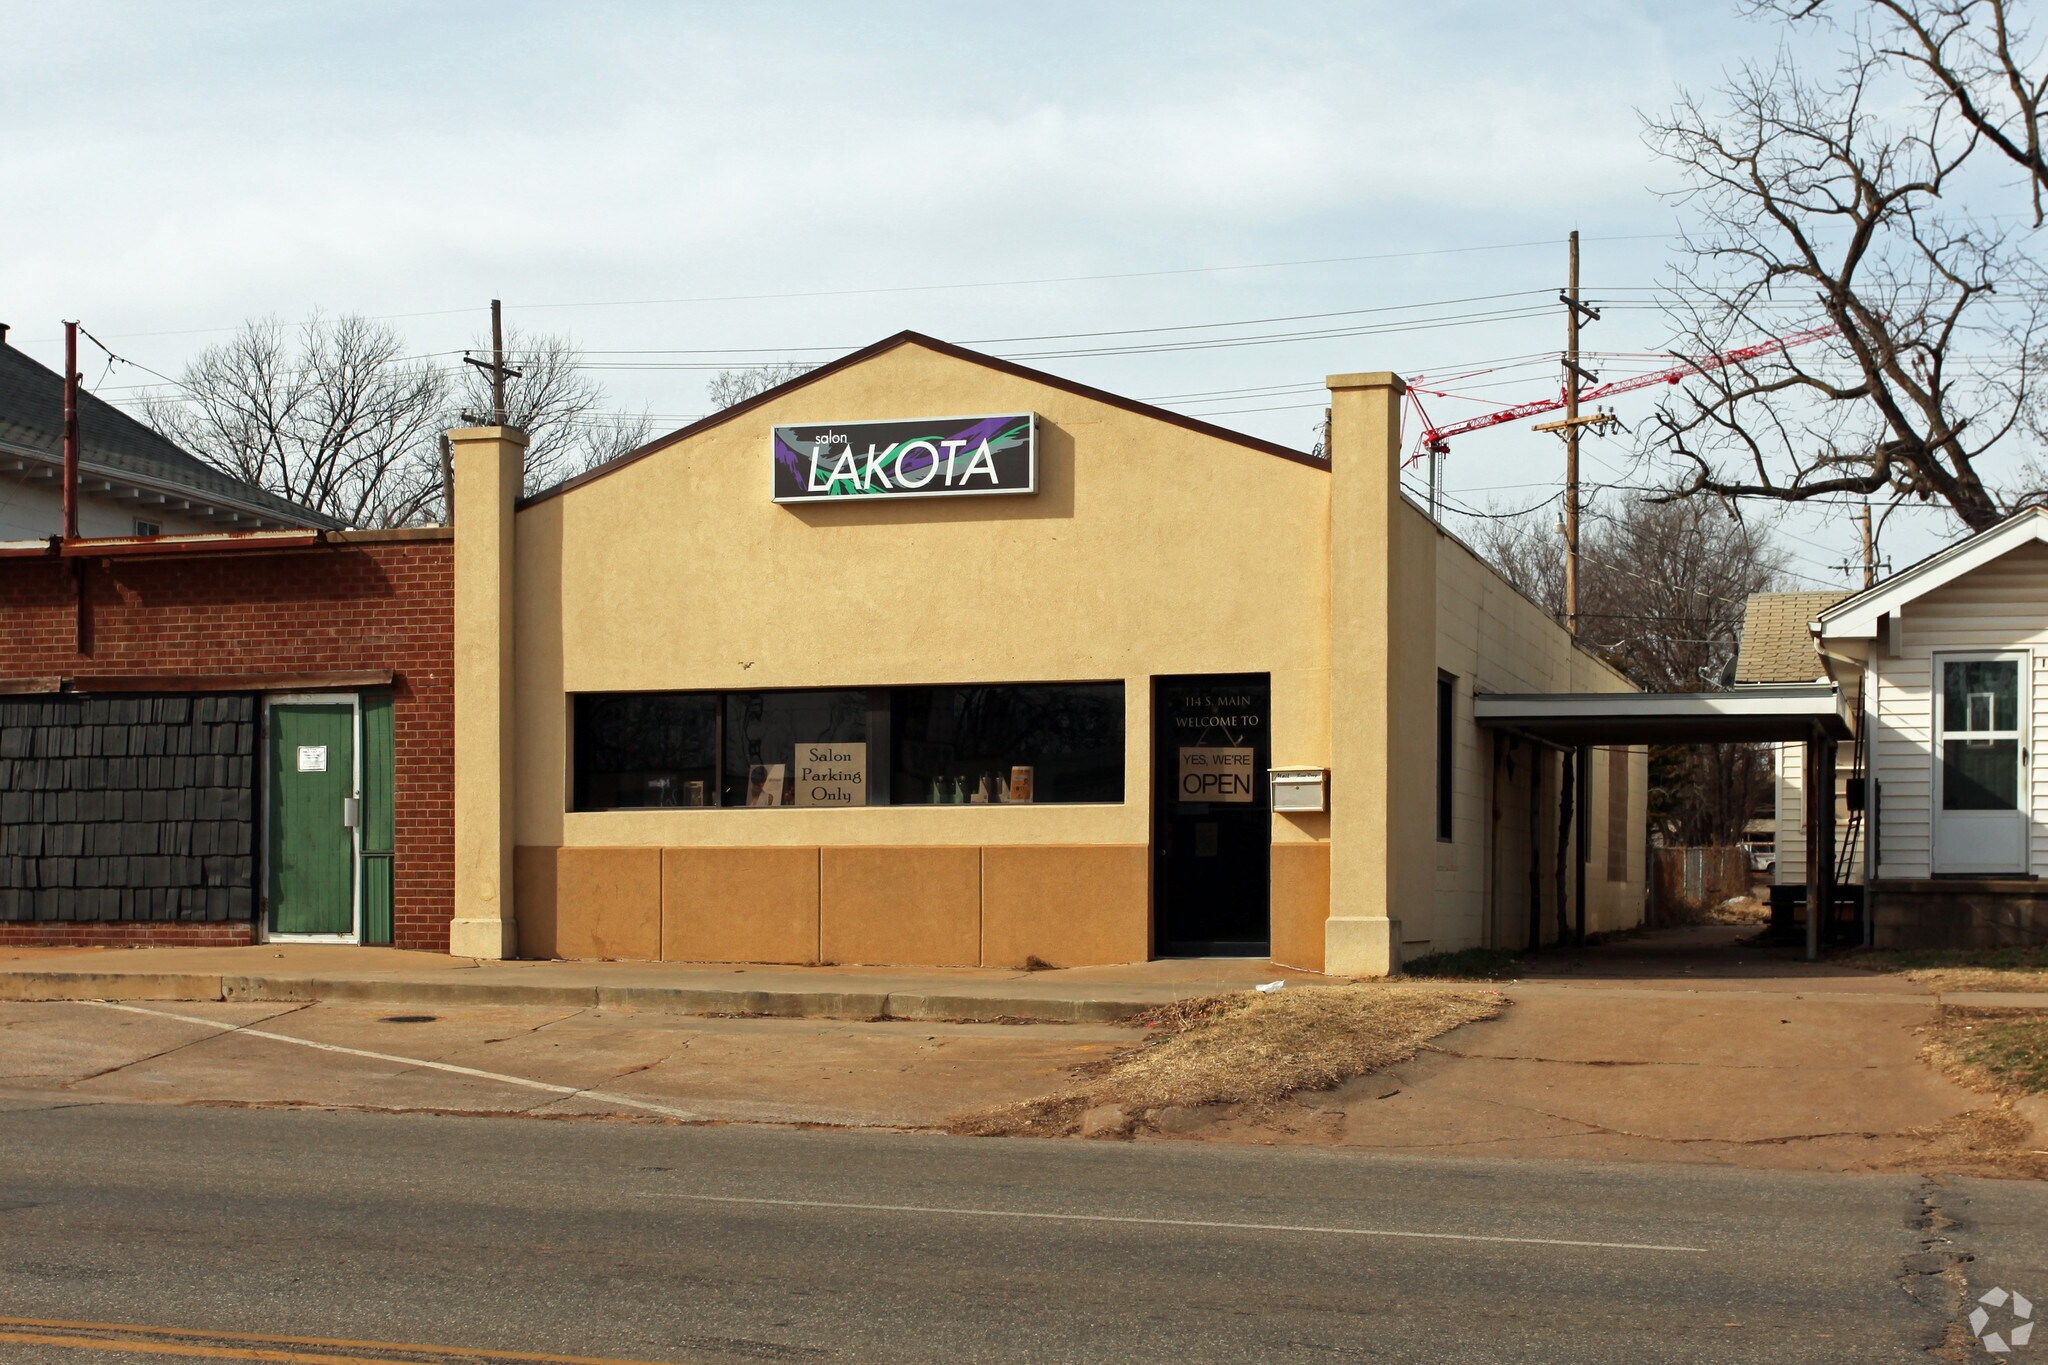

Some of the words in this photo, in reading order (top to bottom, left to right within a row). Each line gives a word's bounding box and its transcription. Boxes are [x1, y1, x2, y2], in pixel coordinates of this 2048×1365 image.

[815, 429, 848, 445] salon
[807, 437, 999, 492] LAKOTA
[1185, 696, 1201, 707] 114
[1217, 695, 1251, 706] MAIN
[1176, 716, 1238, 728] WELCOME
[1240, 715, 1259, 727] TO
[809, 748, 851, 763] Salon
[1183, 754, 1209, 767] YES,
[1212, 754, 1251, 766] WE'RE
[801, 768, 862, 785] Parking
[1183, 773, 1251, 795] OPEN
[811, 786, 852, 803] Only
